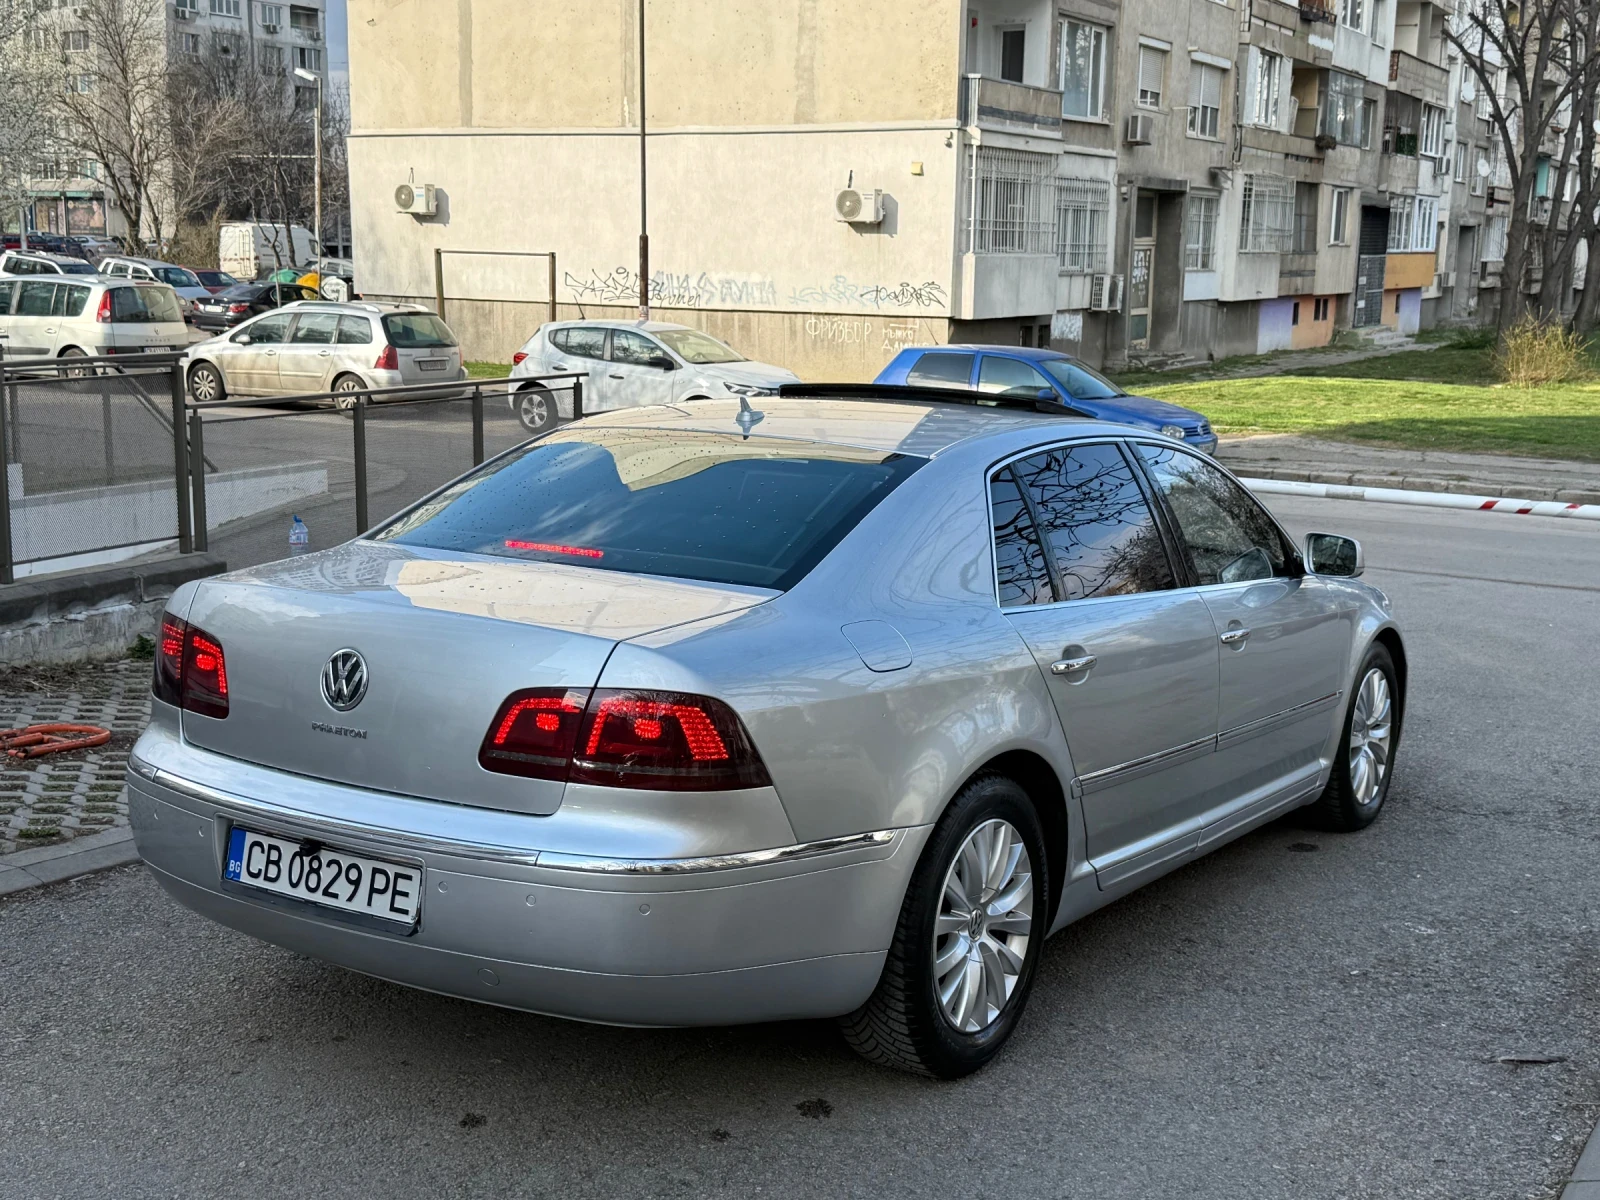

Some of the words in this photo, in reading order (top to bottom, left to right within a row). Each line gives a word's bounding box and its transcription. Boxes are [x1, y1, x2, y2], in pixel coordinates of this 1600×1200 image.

[311, 721, 368, 739] PHAETON
[228, 859, 241, 873] BG
[246, 840, 283, 883] CB
[288, 849, 363, 903] 0829
[366, 866, 413, 916] PE
